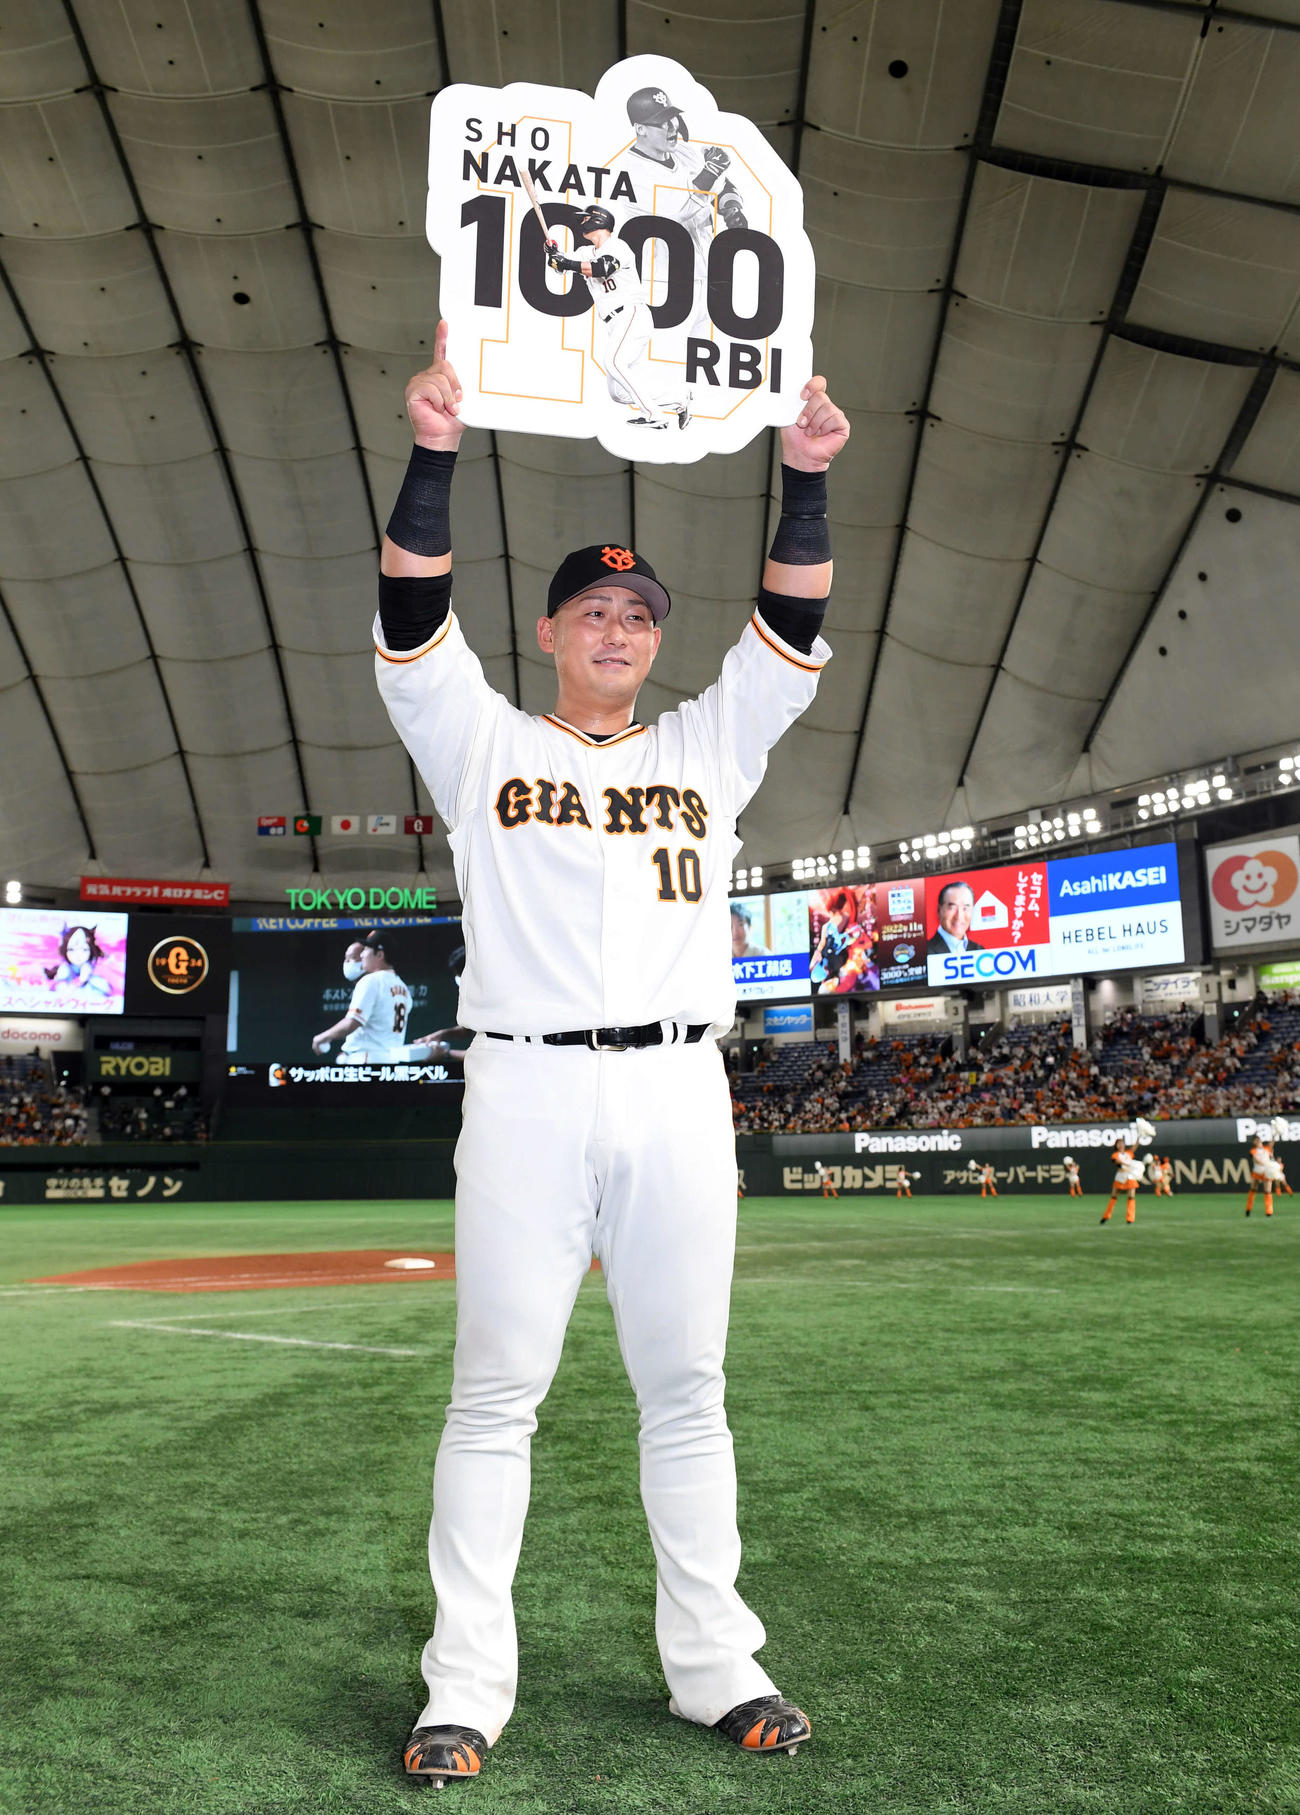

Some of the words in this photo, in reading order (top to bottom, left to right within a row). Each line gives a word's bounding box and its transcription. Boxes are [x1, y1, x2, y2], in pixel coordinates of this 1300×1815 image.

[465, 117, 550, 151] SHO
[462, 149, 637, 204] NAKATA
[460, 194, 785, 341] 1000
[602, 278, 617, 293] 10
[685, 336, 783, 394] RBI
[494, 777, 708, 841] GIANTS
[650, 846, 706, 904] 10
[1059, 866, 1167, 898] AsahiKASEI
[286, 888, 366, 910] TOKYO
[369, 887, 436, 910] DOME
[1011, 871, 1029, 944] してますか?
[1062, 925, 1116, 945] HEBEL
[1122, 919, 1169, 939] HAUS
[1224, 912, 1291, 937] シマダヤ
[167, 946, 189, 975] G
[943, 949, 1037, 980] SECOM
[952, 1006, 959, 1016] 3
[1, 1029, 61, 1041] docomo
[100, 1056, 171, 1077] RYOBI
[289, 1065, 449, 1083] サッポロ生ビール黒ラベル
[854, 1129, 962, 1153] Panasonic
[108, 1176, 183, 1198] セノン
